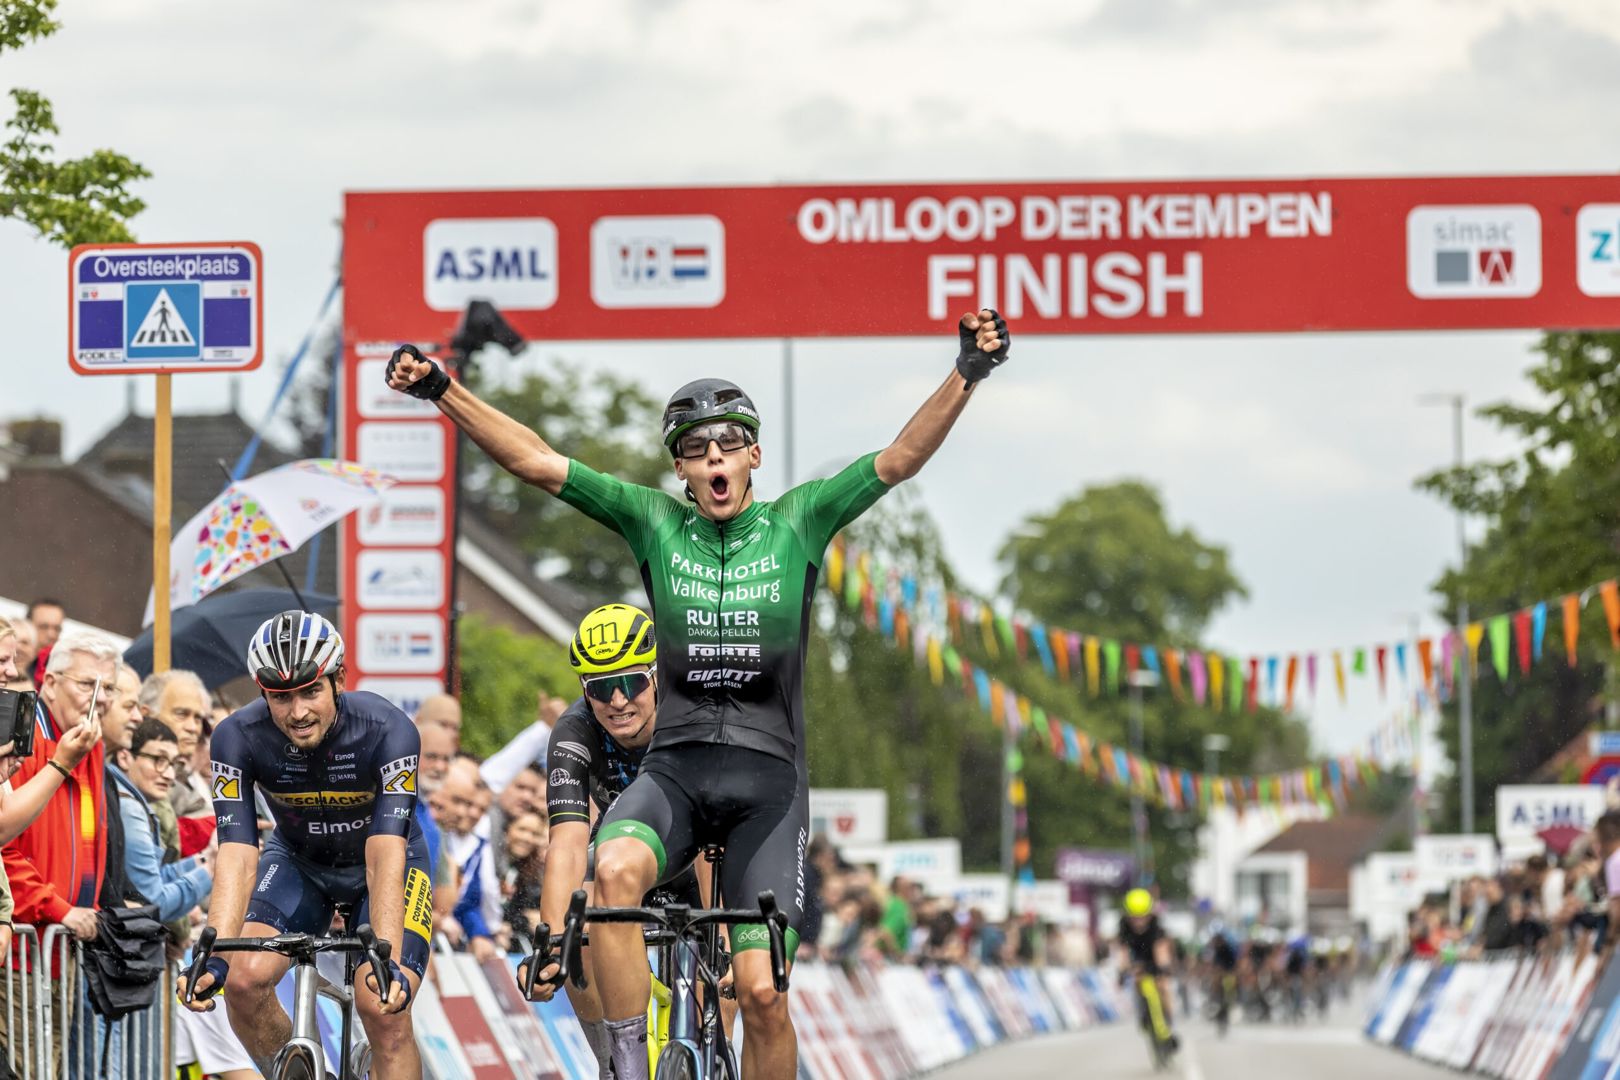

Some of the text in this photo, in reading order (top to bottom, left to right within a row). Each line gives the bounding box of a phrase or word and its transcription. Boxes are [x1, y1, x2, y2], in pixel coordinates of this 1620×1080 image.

[798, 191, 1333, 243] OMLOOP DER KEMPEN
[1434, 216, 1514, 242] simac
[94, 255, 240, 280] Oversteekplaats
[434, 246, 550, 282] ASML
[926, 250, 1204, 321] FINISH
[671, 551, 781, 583] PARKHOTEL
[671, 574, 781, 604] Valkenburg
[686, 609, 760, 627] RUITER
[688, 627, 760, 638] DAKKAPELLEN
[688, 643, 761, 657] FORTE
[687, 668, 762, 682] GIANT
[703, 680, 742, 689] STORE ASSEN
[334, 752, 355, 761] Elmos
[382, 756, 417, 775] HENS
[279, 795, 368, 806] ESCHACHT
[393, 807, 409, 817] FM
[307, 814, 373, 835] Elmos
[257, 863, 279, 892] cannondale
[412, 878, 428, 922] CONTAINERS
